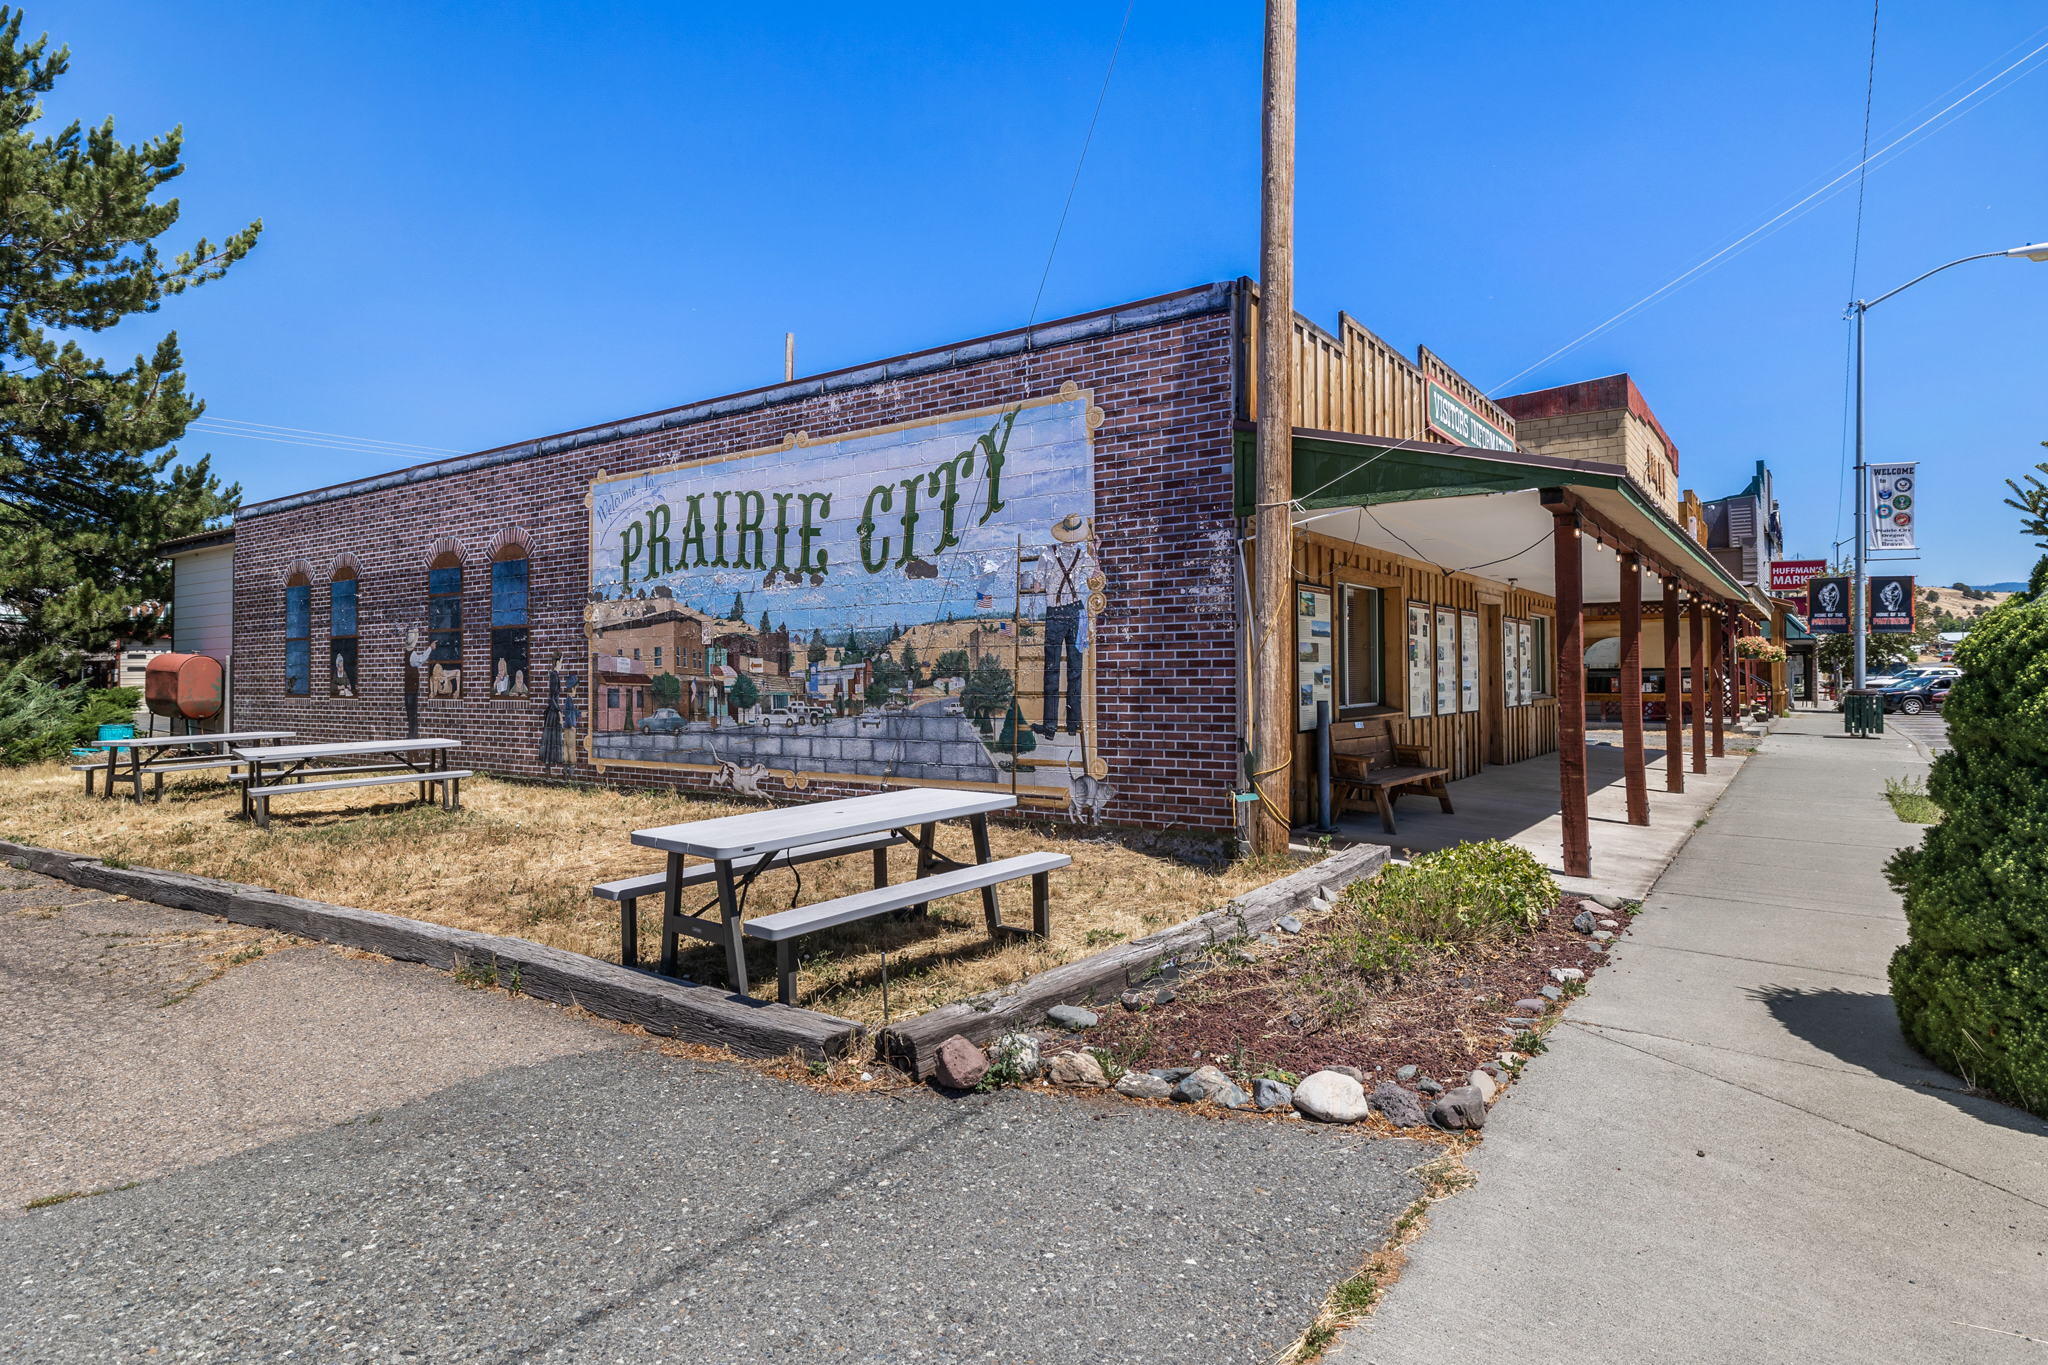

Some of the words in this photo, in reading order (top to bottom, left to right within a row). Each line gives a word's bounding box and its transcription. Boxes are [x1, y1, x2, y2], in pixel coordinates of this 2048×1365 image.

[1433, 391, 1469, 438] VISITORS
[1873, 467, 1914, 476] WELCOME
[597, 485, 637, 524] Welcome
[642, 472, 654, 491] To
[619, 490, 833, 595] PRAIRIE
[858, 404, 1022, 574] CITY
[1772, 566, 1824, 575] HUFFMAN'S
[1873, 617, 1910, 625] PANTHERS
